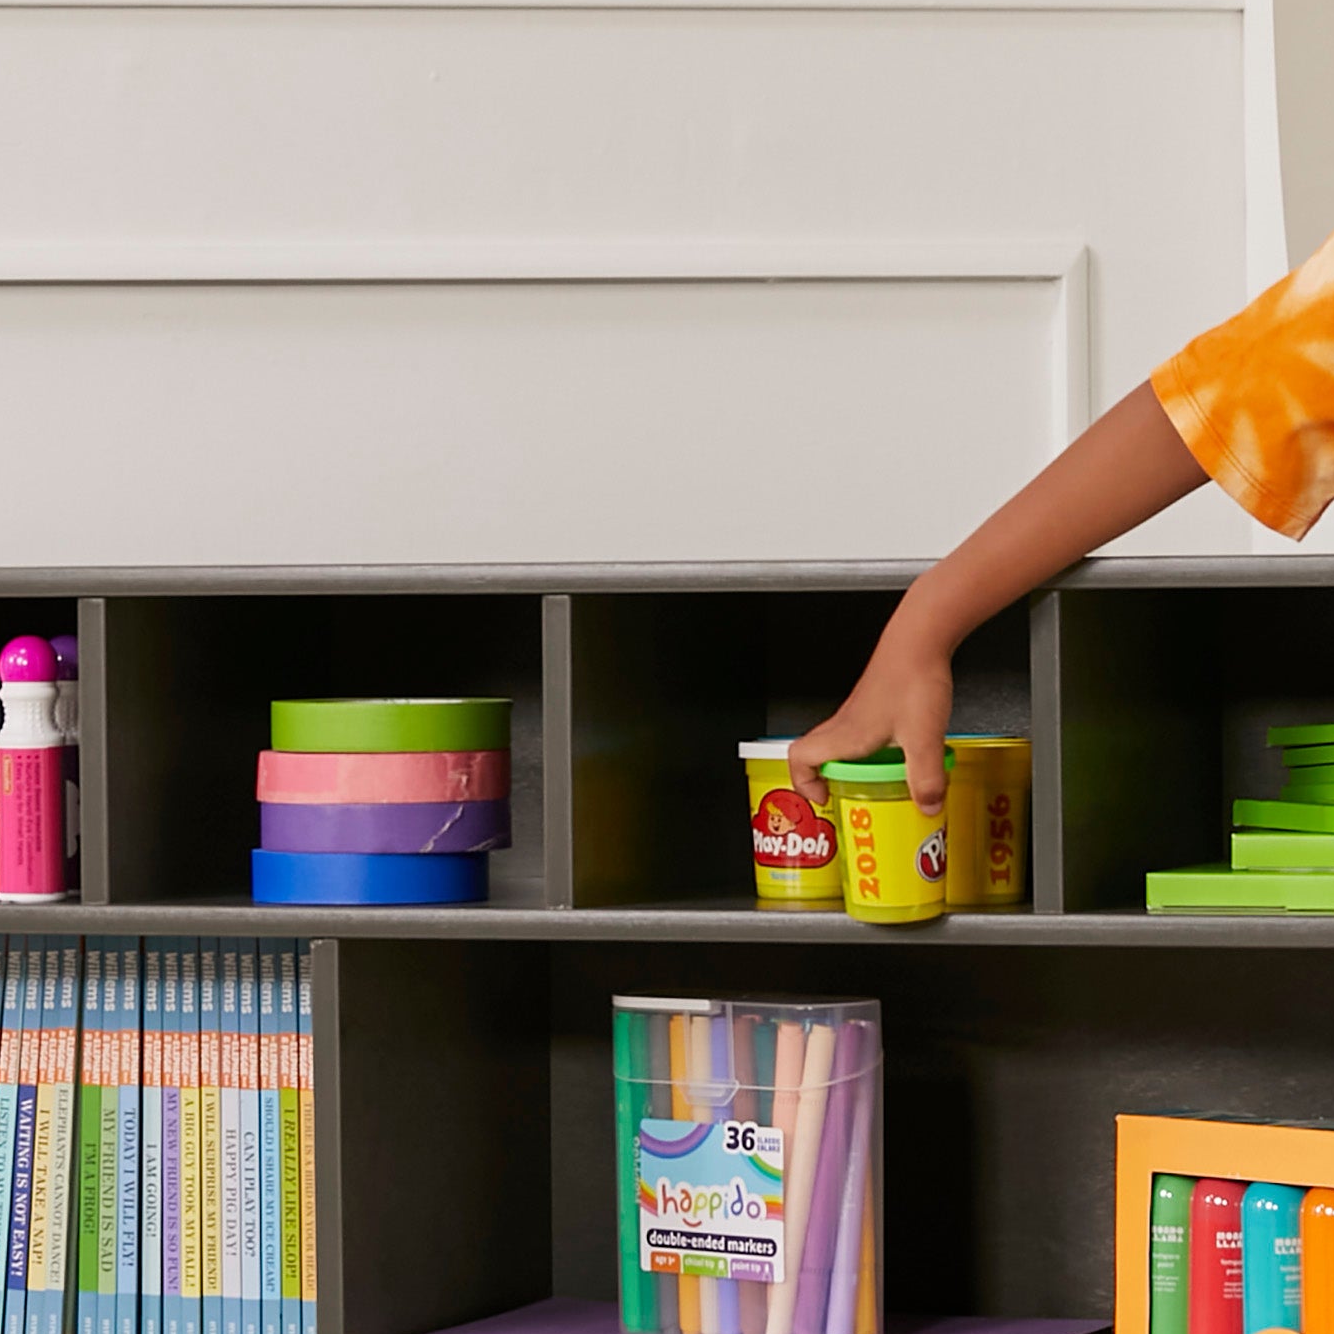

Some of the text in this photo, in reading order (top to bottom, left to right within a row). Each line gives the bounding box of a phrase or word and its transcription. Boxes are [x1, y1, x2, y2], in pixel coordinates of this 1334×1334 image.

[850, 807, 879, 899] 2018
[988, 794, 1013, 886] 1956
[37, 1119, 49, 1160] WILL
[123, 1107, 136, 1163] TODAY
[243, 1131, 255, 1162] CAN
[283, 1119, 296, 1187] REALLY
[726, 1126, 755, 1151] 36
[146, 1153, 156, 1177] AM
[9, 1098, 33, 1276] WAITING IS NOT EASY!
[34, 1164, 47, 1207] TAKE
[122, 1180, 135, 1225] WILL
[225, 1129, 237, 1256] HAPPY PIG DAY!
[243, 1176, 255, 1214] PLAY
[662, 1184, 761, 1219] happido
[33, 1212, 44, 1222] A
[145, 1182, 156, 1237] GOING!
[284, 1189, 296, 1228] LIKE
[31, 1227, 44, 1265] NAP!
[122, 1230, 134, 1266] FLY!
[244, 1219, 256, 1257] TOO?
[284, 1233, 297, 1278] SLOP!
[649, 1231, 774, 1254] double-ended markers
